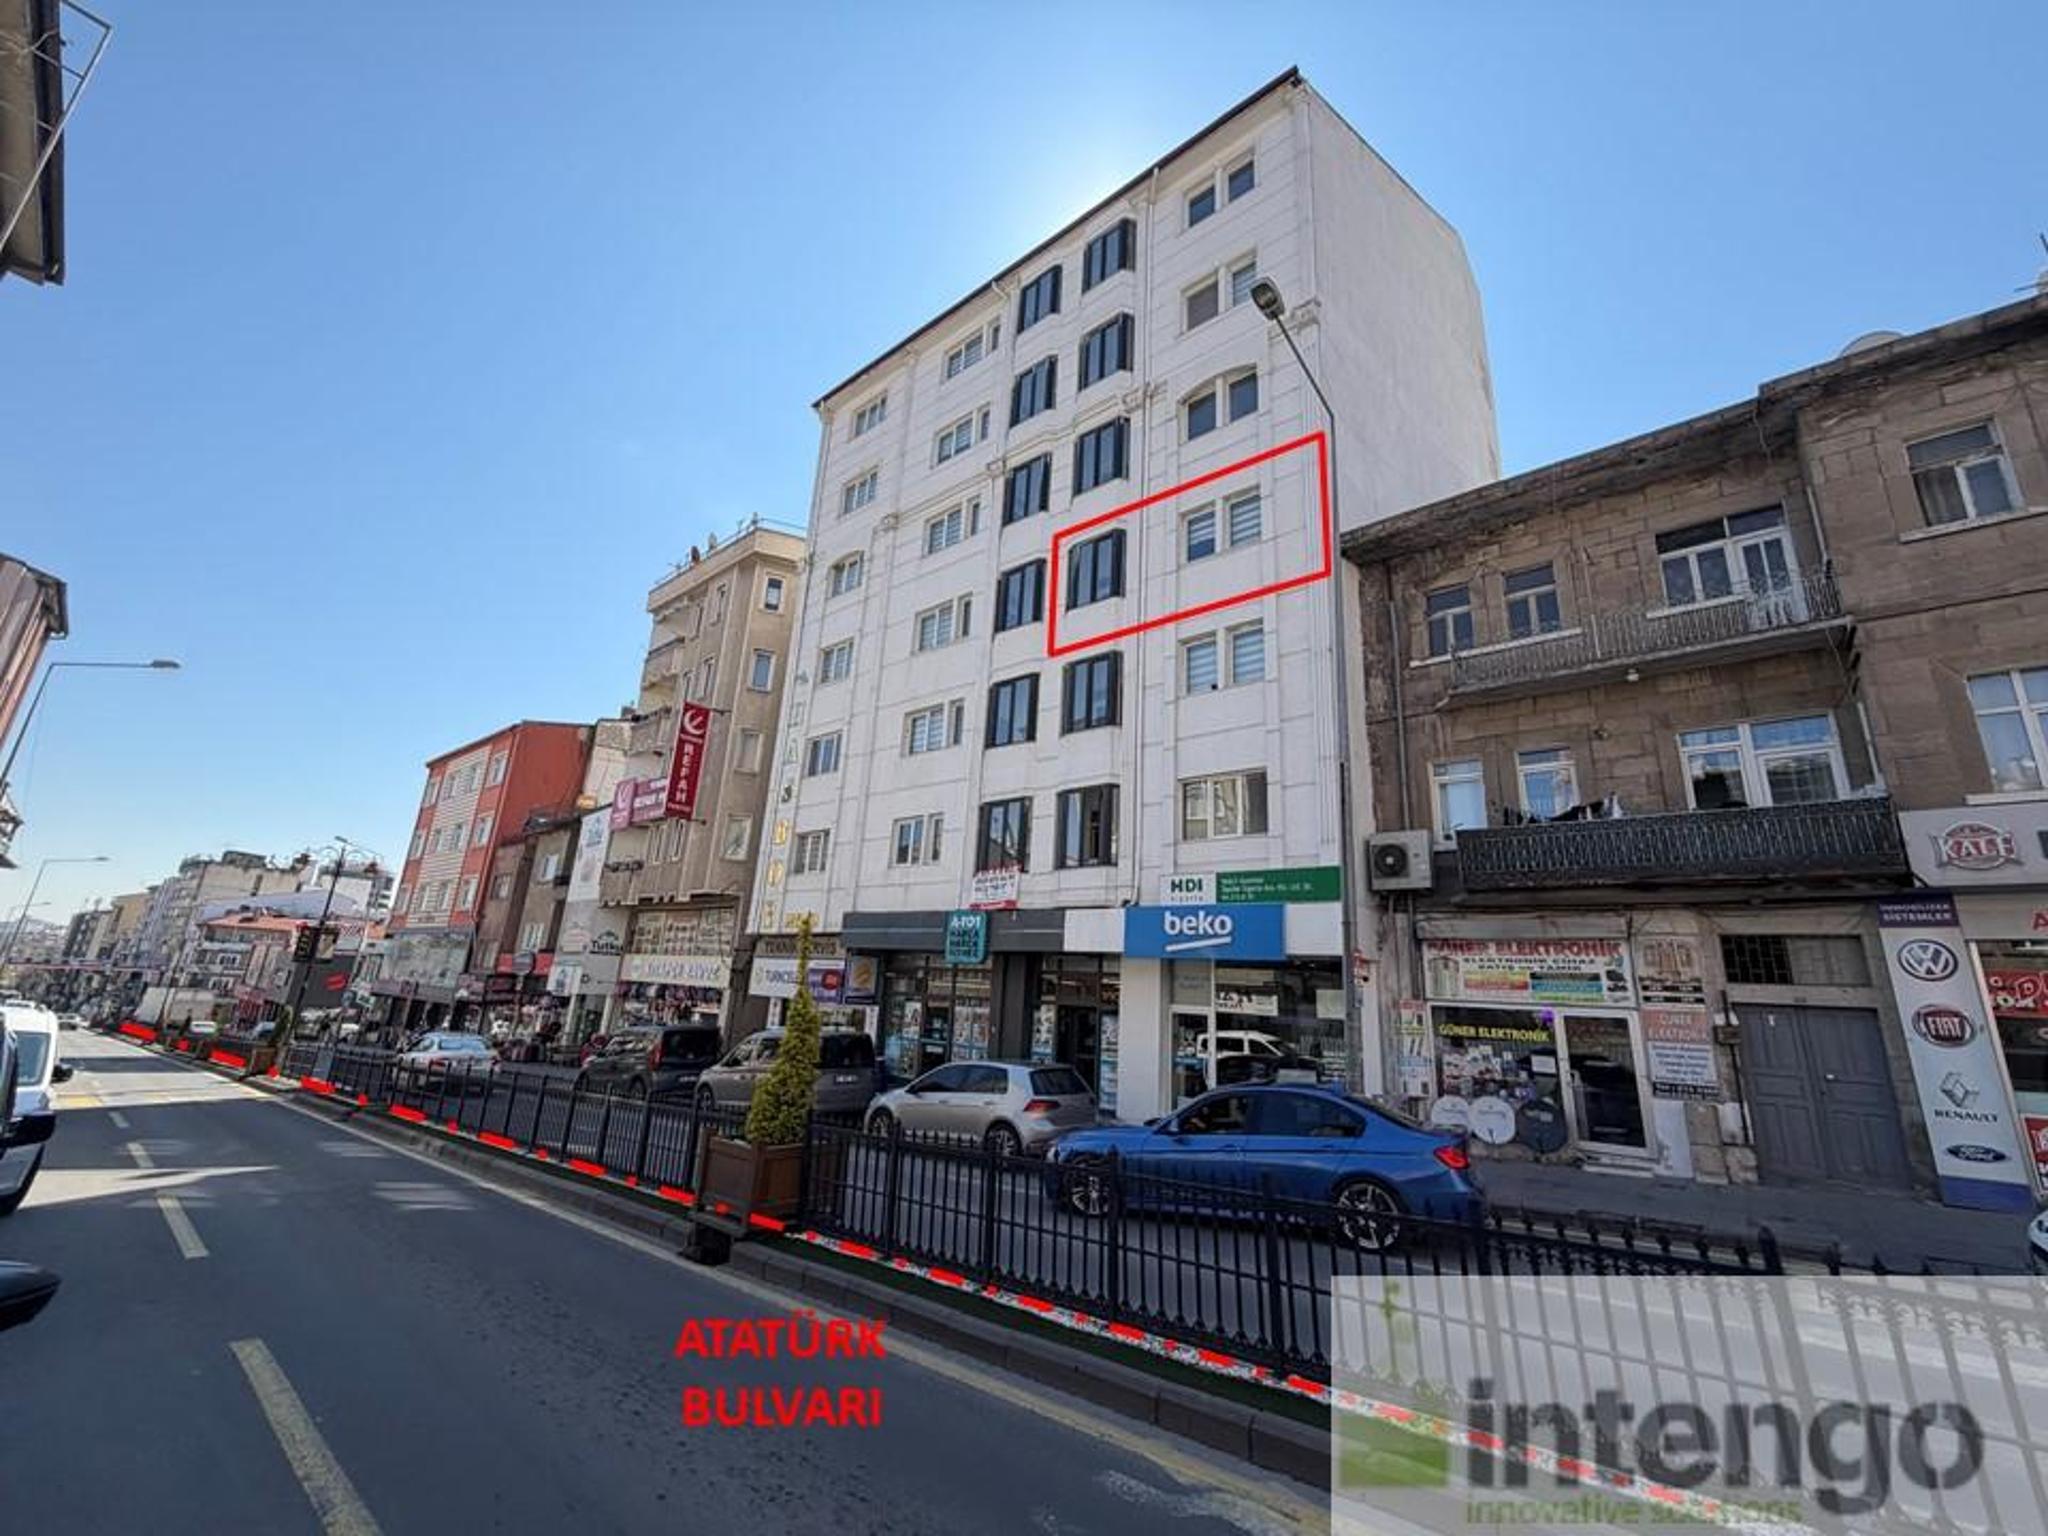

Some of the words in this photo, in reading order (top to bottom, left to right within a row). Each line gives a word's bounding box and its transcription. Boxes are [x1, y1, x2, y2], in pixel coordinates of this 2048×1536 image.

[1170, 878, 1203, 893] HDI
[1164, 910, 1233, 935] beko
[1478, 1025, 1551, 1042] ELEKTRONİK
[1927, 1016, 1962, 1037] FIAT
[1934, 1108, 1999, 1123] RENAULT
[1959, 1146, 1995, 1161] Ford
